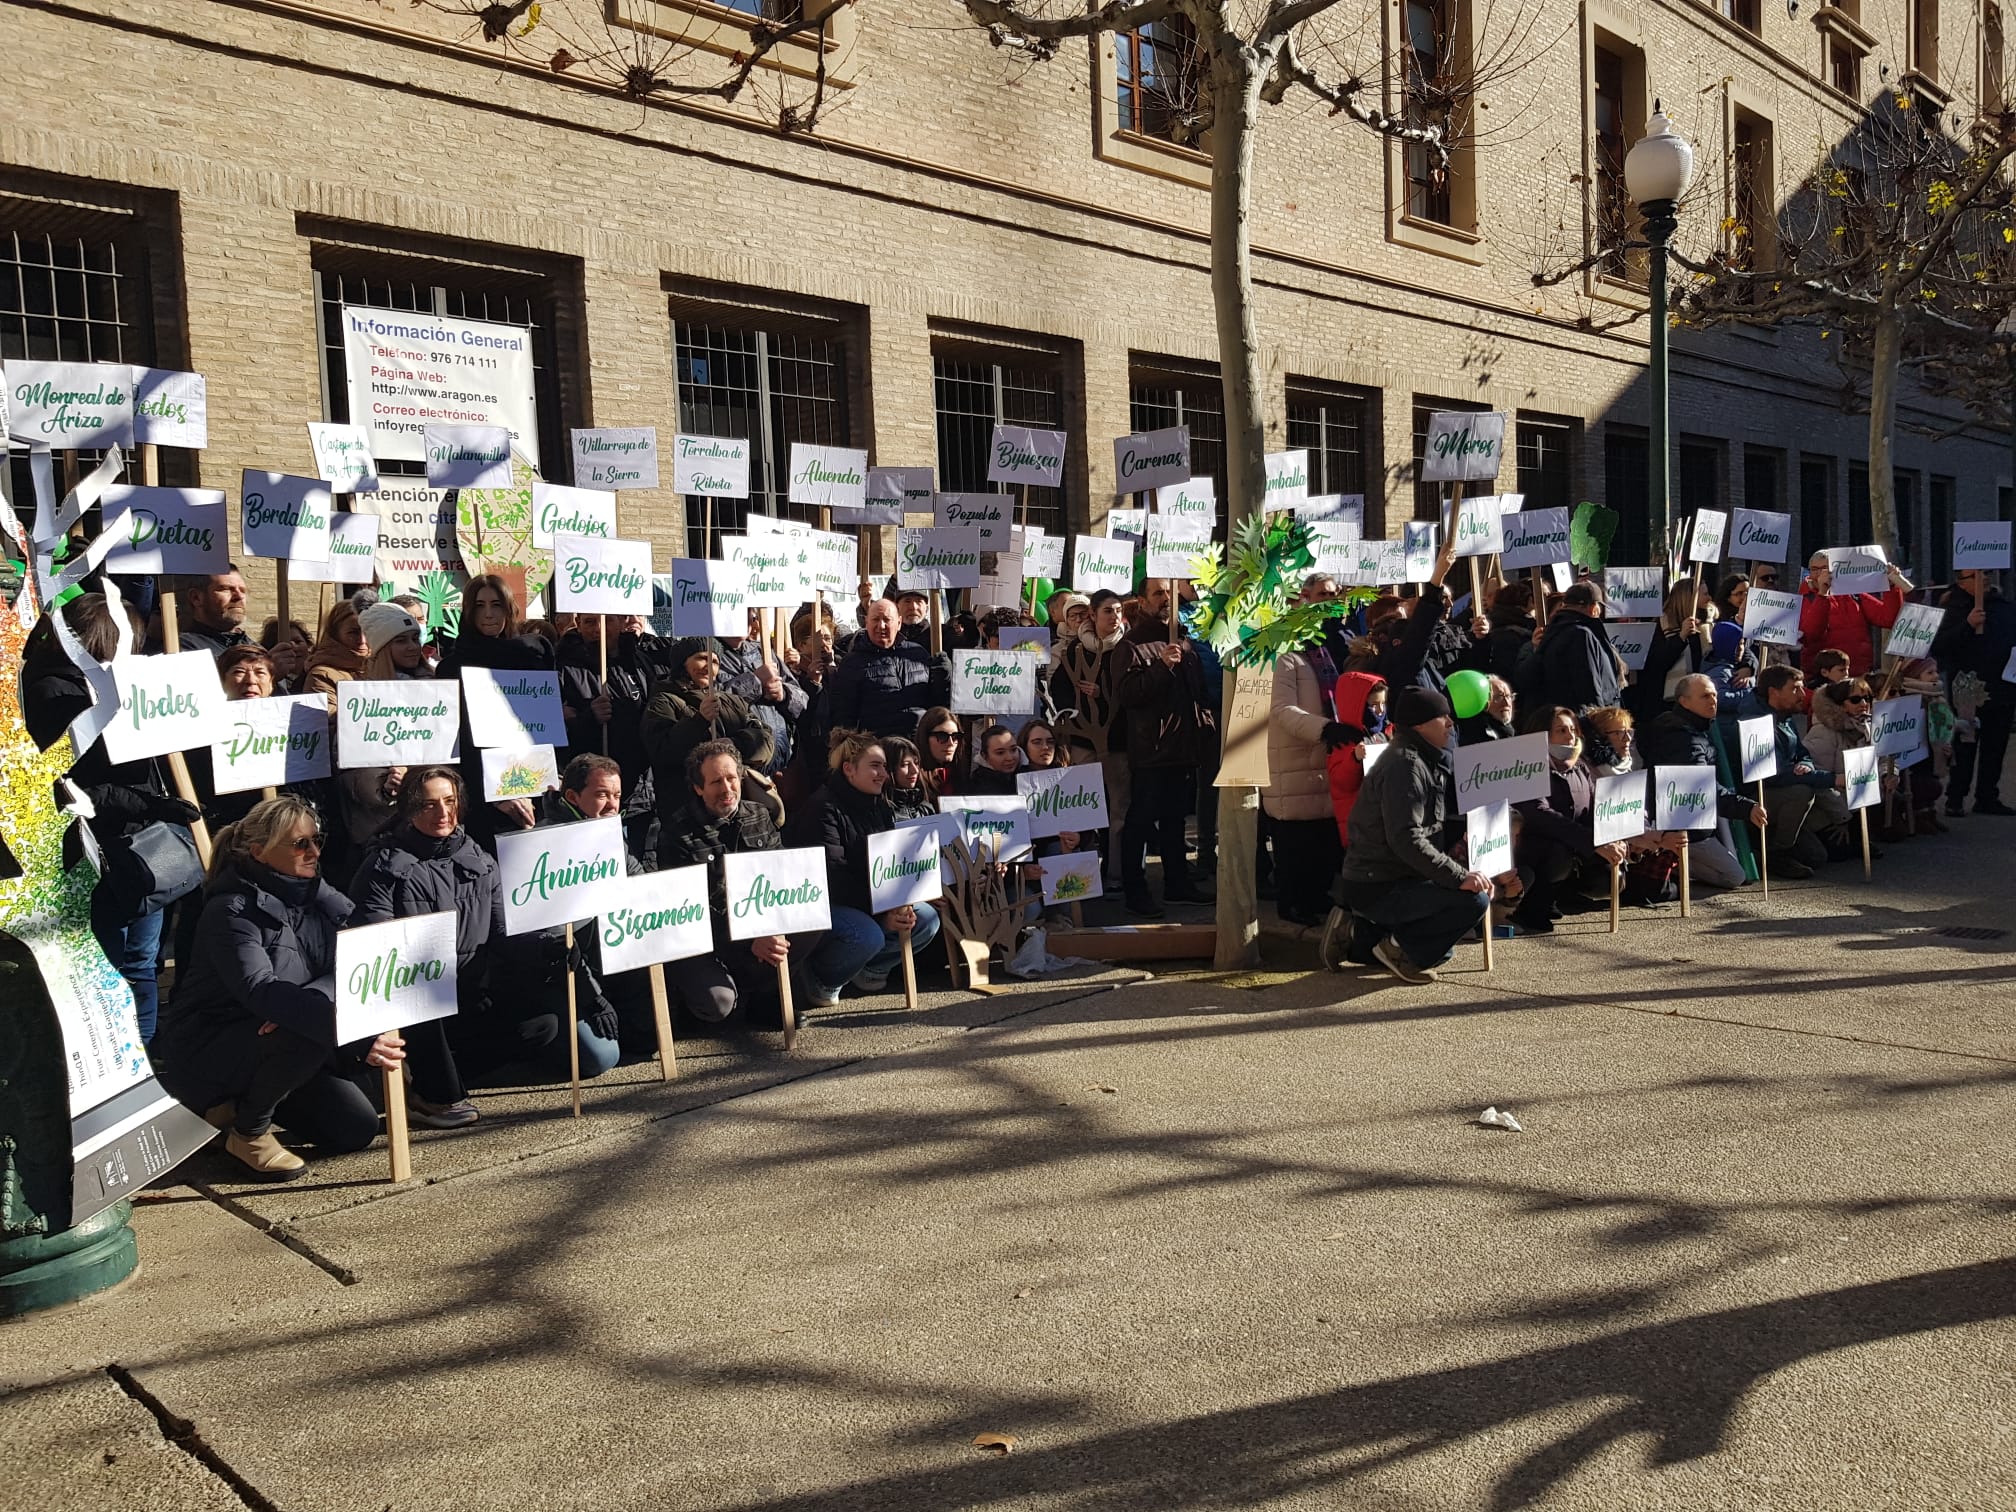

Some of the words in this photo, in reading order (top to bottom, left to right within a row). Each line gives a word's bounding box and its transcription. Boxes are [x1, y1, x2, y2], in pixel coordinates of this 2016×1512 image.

[351, 317, 457, 343] Información
[460, 331, 523, 351] General
[430, 353, 452, 364] 976
[455, 355, 476, 366] 714
[479, 358, 498, 369] 111
[371, 366, 414, 382] Página
[416, 371, 447, 383] Web:
[16, 382, 103, 408] Monreal
[105, 388, 126, 406] de
[134, 384, 188, 424] odos
[371, 382, 498, 404] http://www.aragon.es
[41, 405, 104, 433] Ariza
[373, 402, 416, 417] Correo
[418, 407, 489, 423] electrónico:
[579, 436, 637, 455] Villarroya
[638, 437, 650, 450] de
[679, 438, 730, 458] Torralba
[731, 446, 744, 459] de
[997, 441, 1059, 470] Bijuesca
[1433, 427, 1497, 461] Moros
[592, 467, 603, 481] la
[605, 466, 641, 483] Sierra
[795, 459, 864, 486] Aluenda
[1121, 450, 1186, 478] Carenas
[691, 473, 733, 492] Ribota
[246, 493, 327, 531] Bordalba
[946, 503, 988, 522] Pozuel
[988, 506, 1002, 521] de
[1167, 491, 1207, 516] Ateca
[127, 508, 214, 551] Pietas
[392, 512, 423, 524] con
[540, 503, 610, 538] Godojos
[377, 534, 447, 549] Reserve
[1503, 528, 1568, 554] Calmarza
[1739, 521, 1780, 546] Cetina
[1955, 535, 2008, 556] Contamina
[392, 558, 465, 571] www.ara
[1077, 551, 1131, 579] Valtorres
[565, 557, 647, 599] Berdejo
[1607, 584, 1660, 602] Monterde
[965, 657, 1008, 678] Fuentes
[1008, 662, 1022, 676] de
[539, 680, 554, 696] de
[974, 676, 1012, 699] Jiloca
[346, 698, 430, 723] Villarroya
[431, 699, 448, 717] de
[363, 722, 380, 742] la
[382, 720, 433, 745] Sierra
[1874, 712, 1916, 743] Jaraba
[221, 722, 321, 766] Purroy
[1460, 759, 1546, 793] Arándiga
[1027, 783, 1099, 818] Miedes
[1666, 781, 1707, 813] Inogés
[960, 808, 1014, 835] Terrer
[512, 851, 619, 906] Aniñón
[872, 849, 938, 889] Calatayud
[733, 873, 822, 919] Abanto
[604, 899, 704, 948] Sisamón
[349, 947, 446, 1005] Mara
